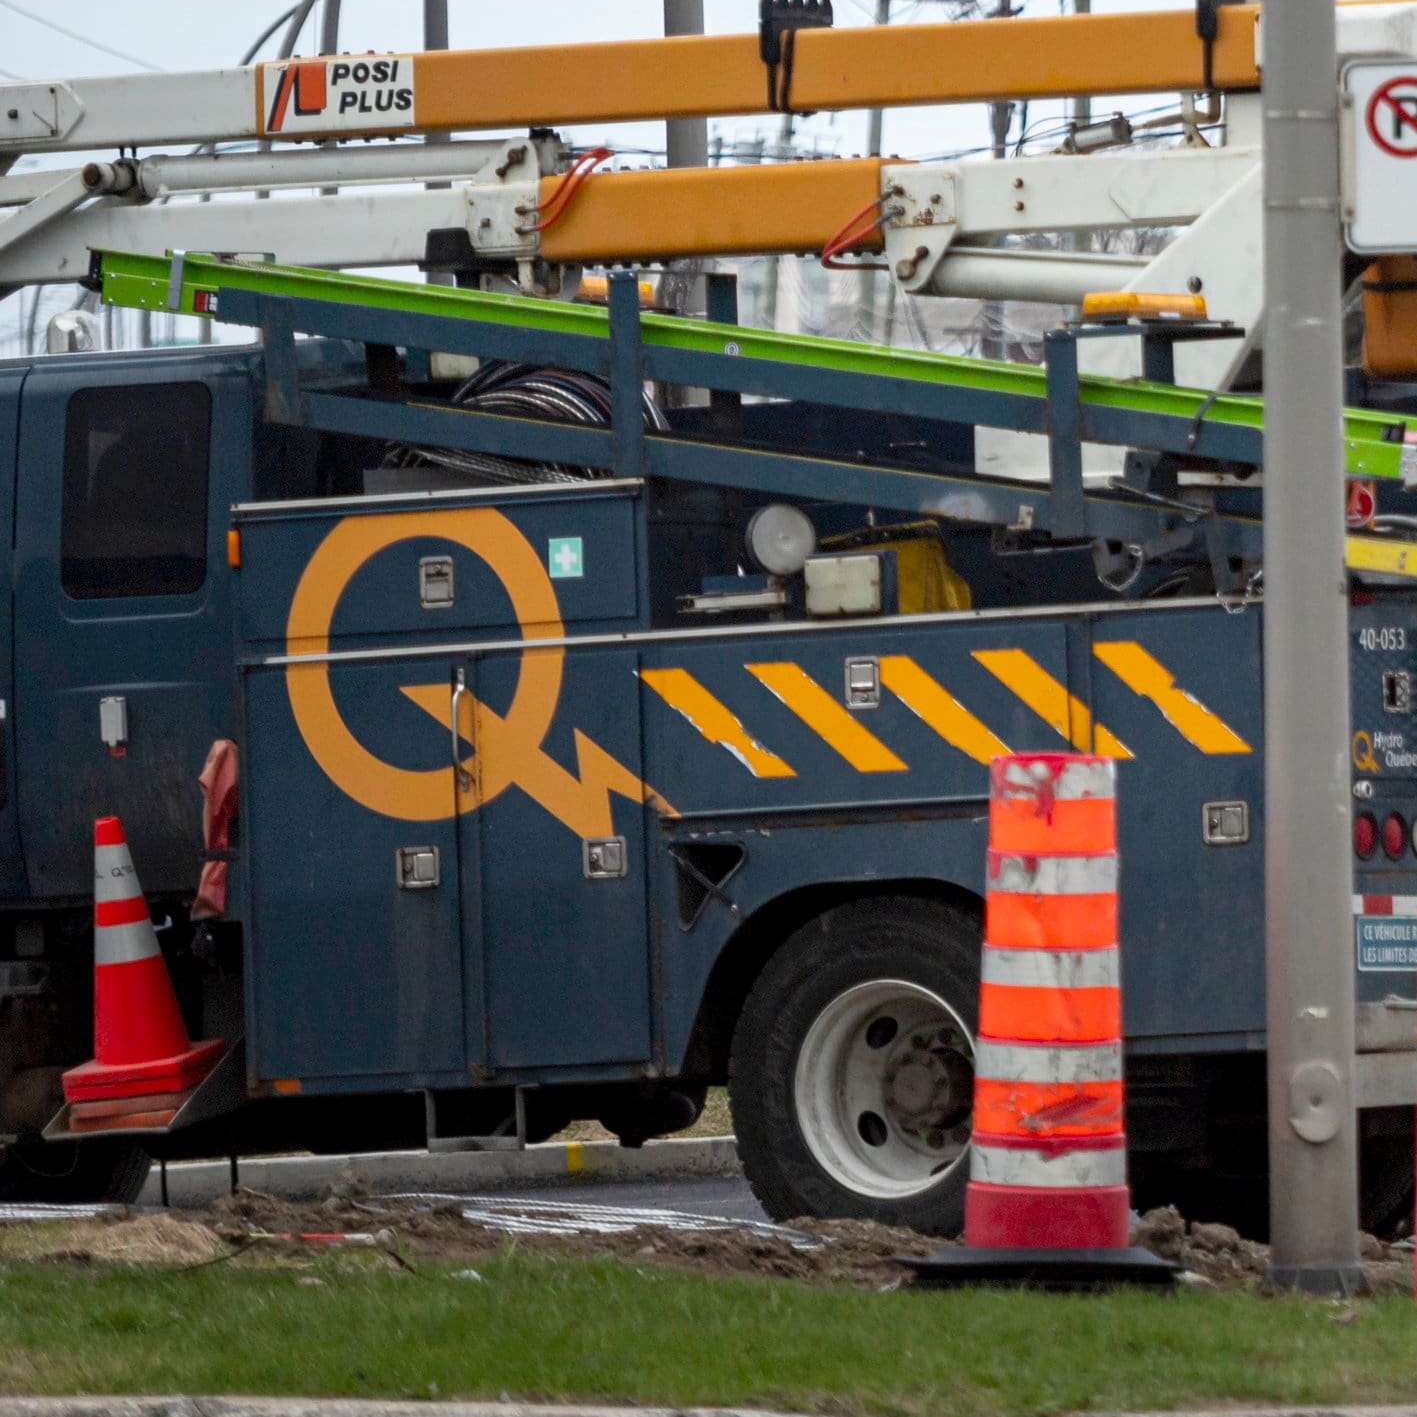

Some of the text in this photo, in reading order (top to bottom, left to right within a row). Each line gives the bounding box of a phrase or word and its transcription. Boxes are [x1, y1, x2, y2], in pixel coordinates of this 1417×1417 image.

[331, 60, 399, 86] POSI
[339, 88, 413, 114] PLUS
[1359, 628, 1405, 650] 40-053
[1374, 732, 1403, 751] Hydro
[1363, 925, 1373, 941] CE
[1374, 924, 1411, 941] VÉHICULE
[1363, 947, 1377, 963] LES
[1378, 947, 1408, 963] LIMITES
